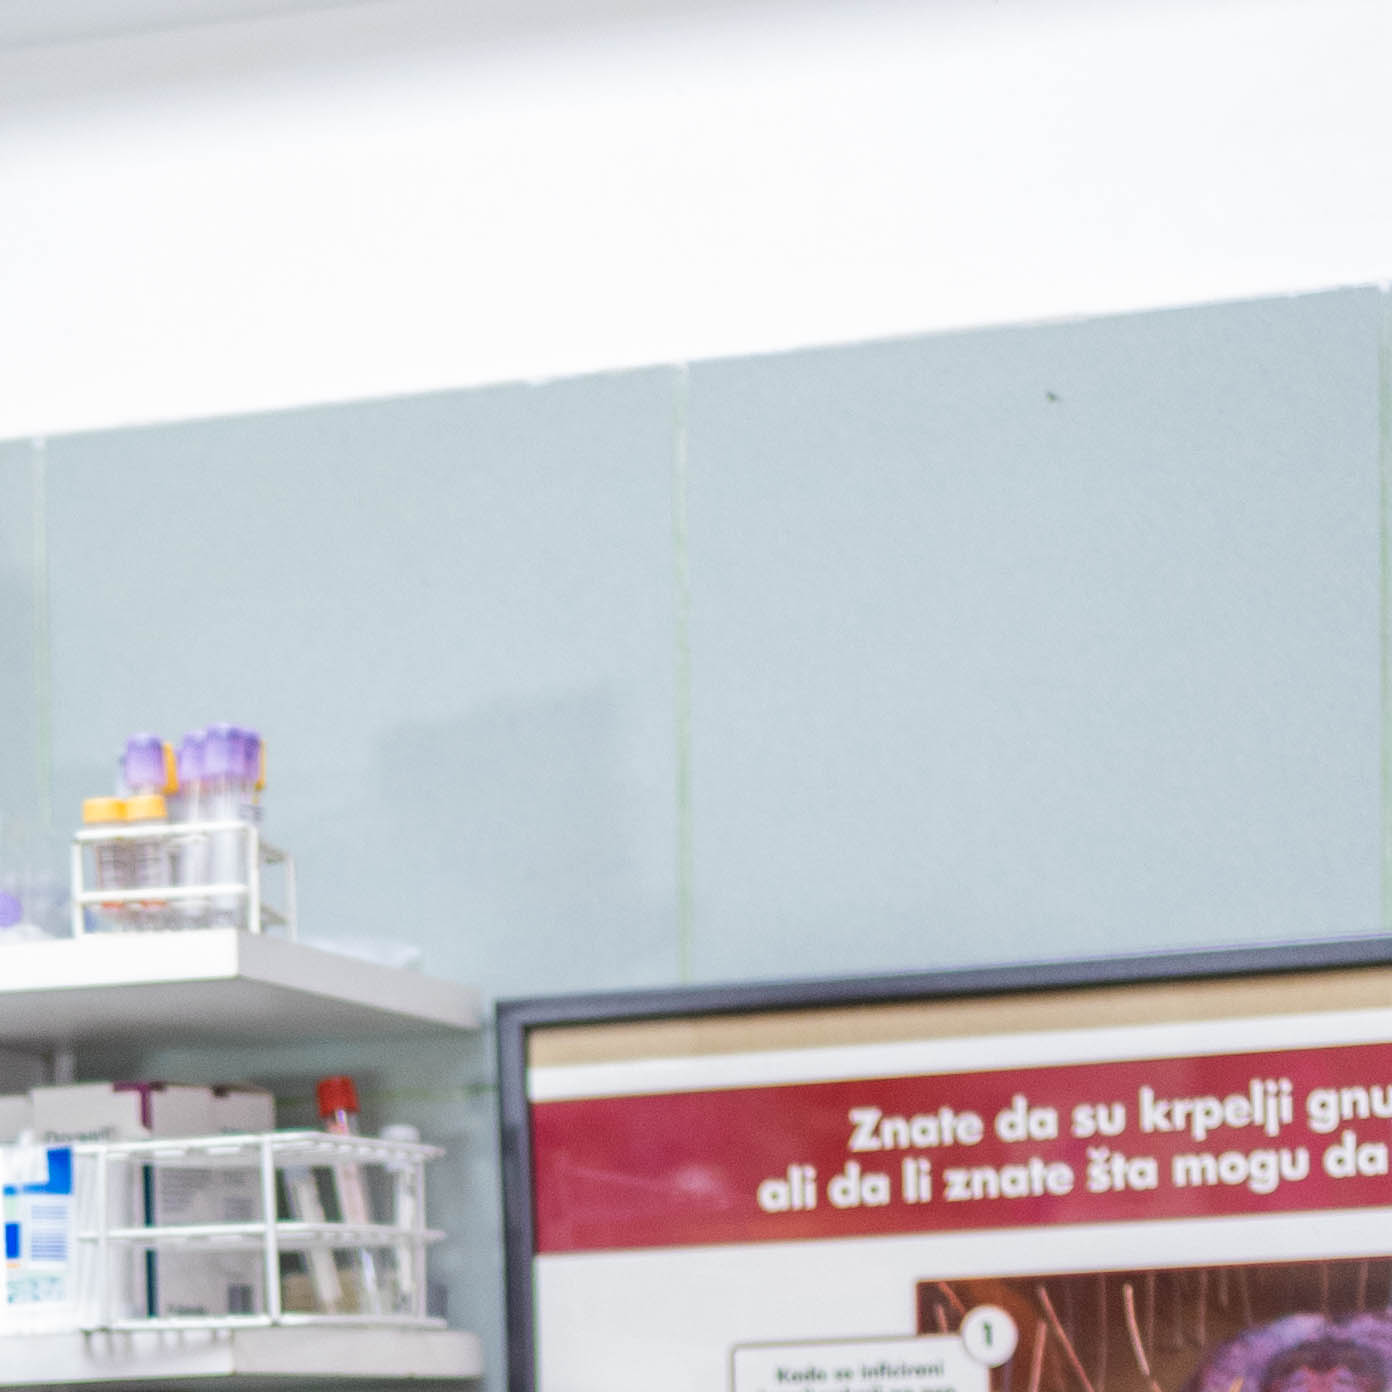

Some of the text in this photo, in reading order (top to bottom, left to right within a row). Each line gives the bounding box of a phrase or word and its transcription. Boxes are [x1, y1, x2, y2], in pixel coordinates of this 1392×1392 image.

[848, 1105, 984, 1152] Znate
[995, 1093, 1058, 1143] da
[1072, 1102, 1126, 1138] su
[1138, 1077, 1293, 1141] krpelji
[758, 1129, 1389, 1213] ali da li znate šta mogu da
[982, 1320, 993, 1346] 1
